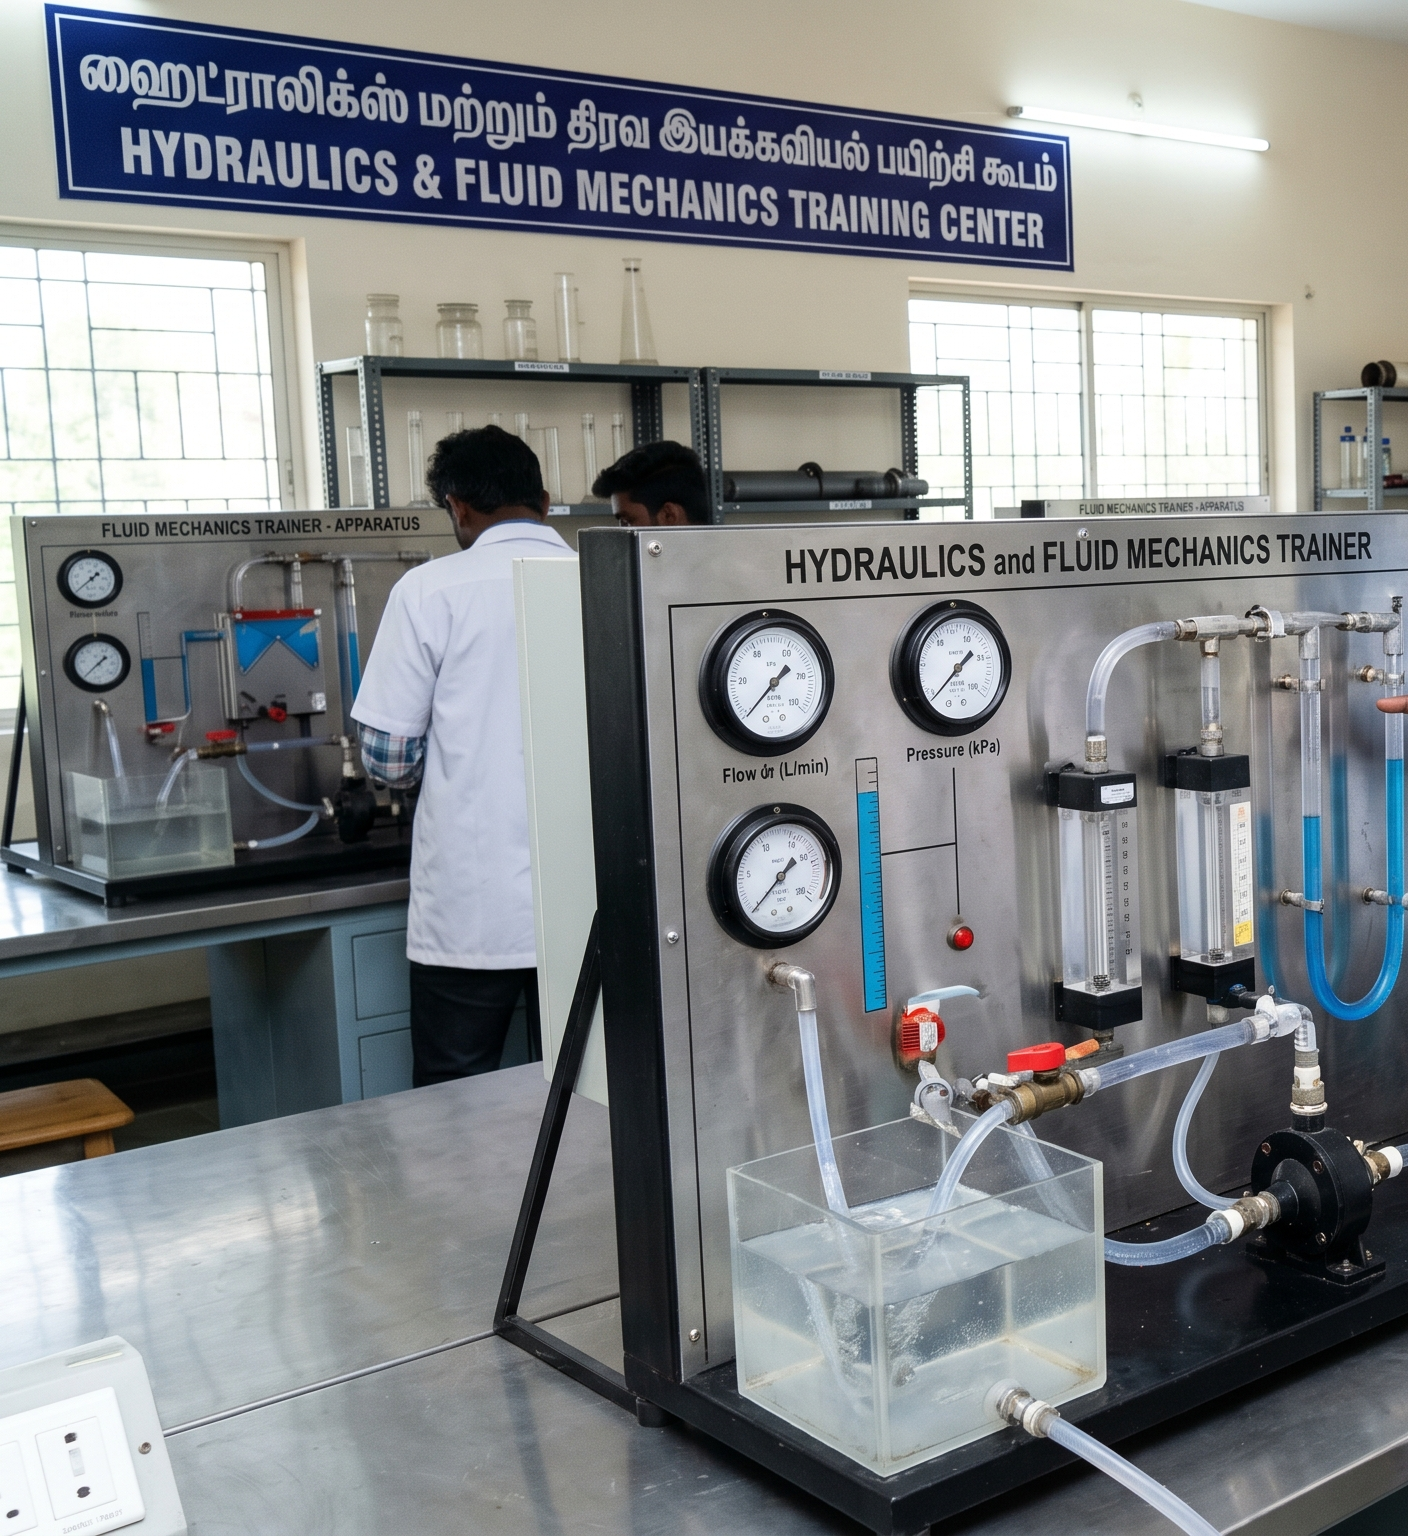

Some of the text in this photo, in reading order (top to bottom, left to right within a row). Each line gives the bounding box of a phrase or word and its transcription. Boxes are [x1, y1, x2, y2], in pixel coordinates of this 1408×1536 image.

[79, 53, 1058, 193] ஹைட்ராலிக்ஸ் மற்றும் திரவ இயக்கவியல் பயிற்சி கூடம்
[120, 126, 1045, 249] HYDRAULICS & FLUID MECHANICS TRAINING CENTER
[101, 521, 150, 538] FLUID
[154, 519, 251, 537] MECHANICS
[255, 518, 322, 535] TRAINER
[334, 516, 421, 533] APPARATUS
[785, 531, 1372, 584] HYDRAULICS and FLUID MECHANICS TRAINER
[722, 767, 757, 784] Flow
[779, 756, 829, 782] (L/min)
[907, 737, 1000, 763] Pressure (kPa)
